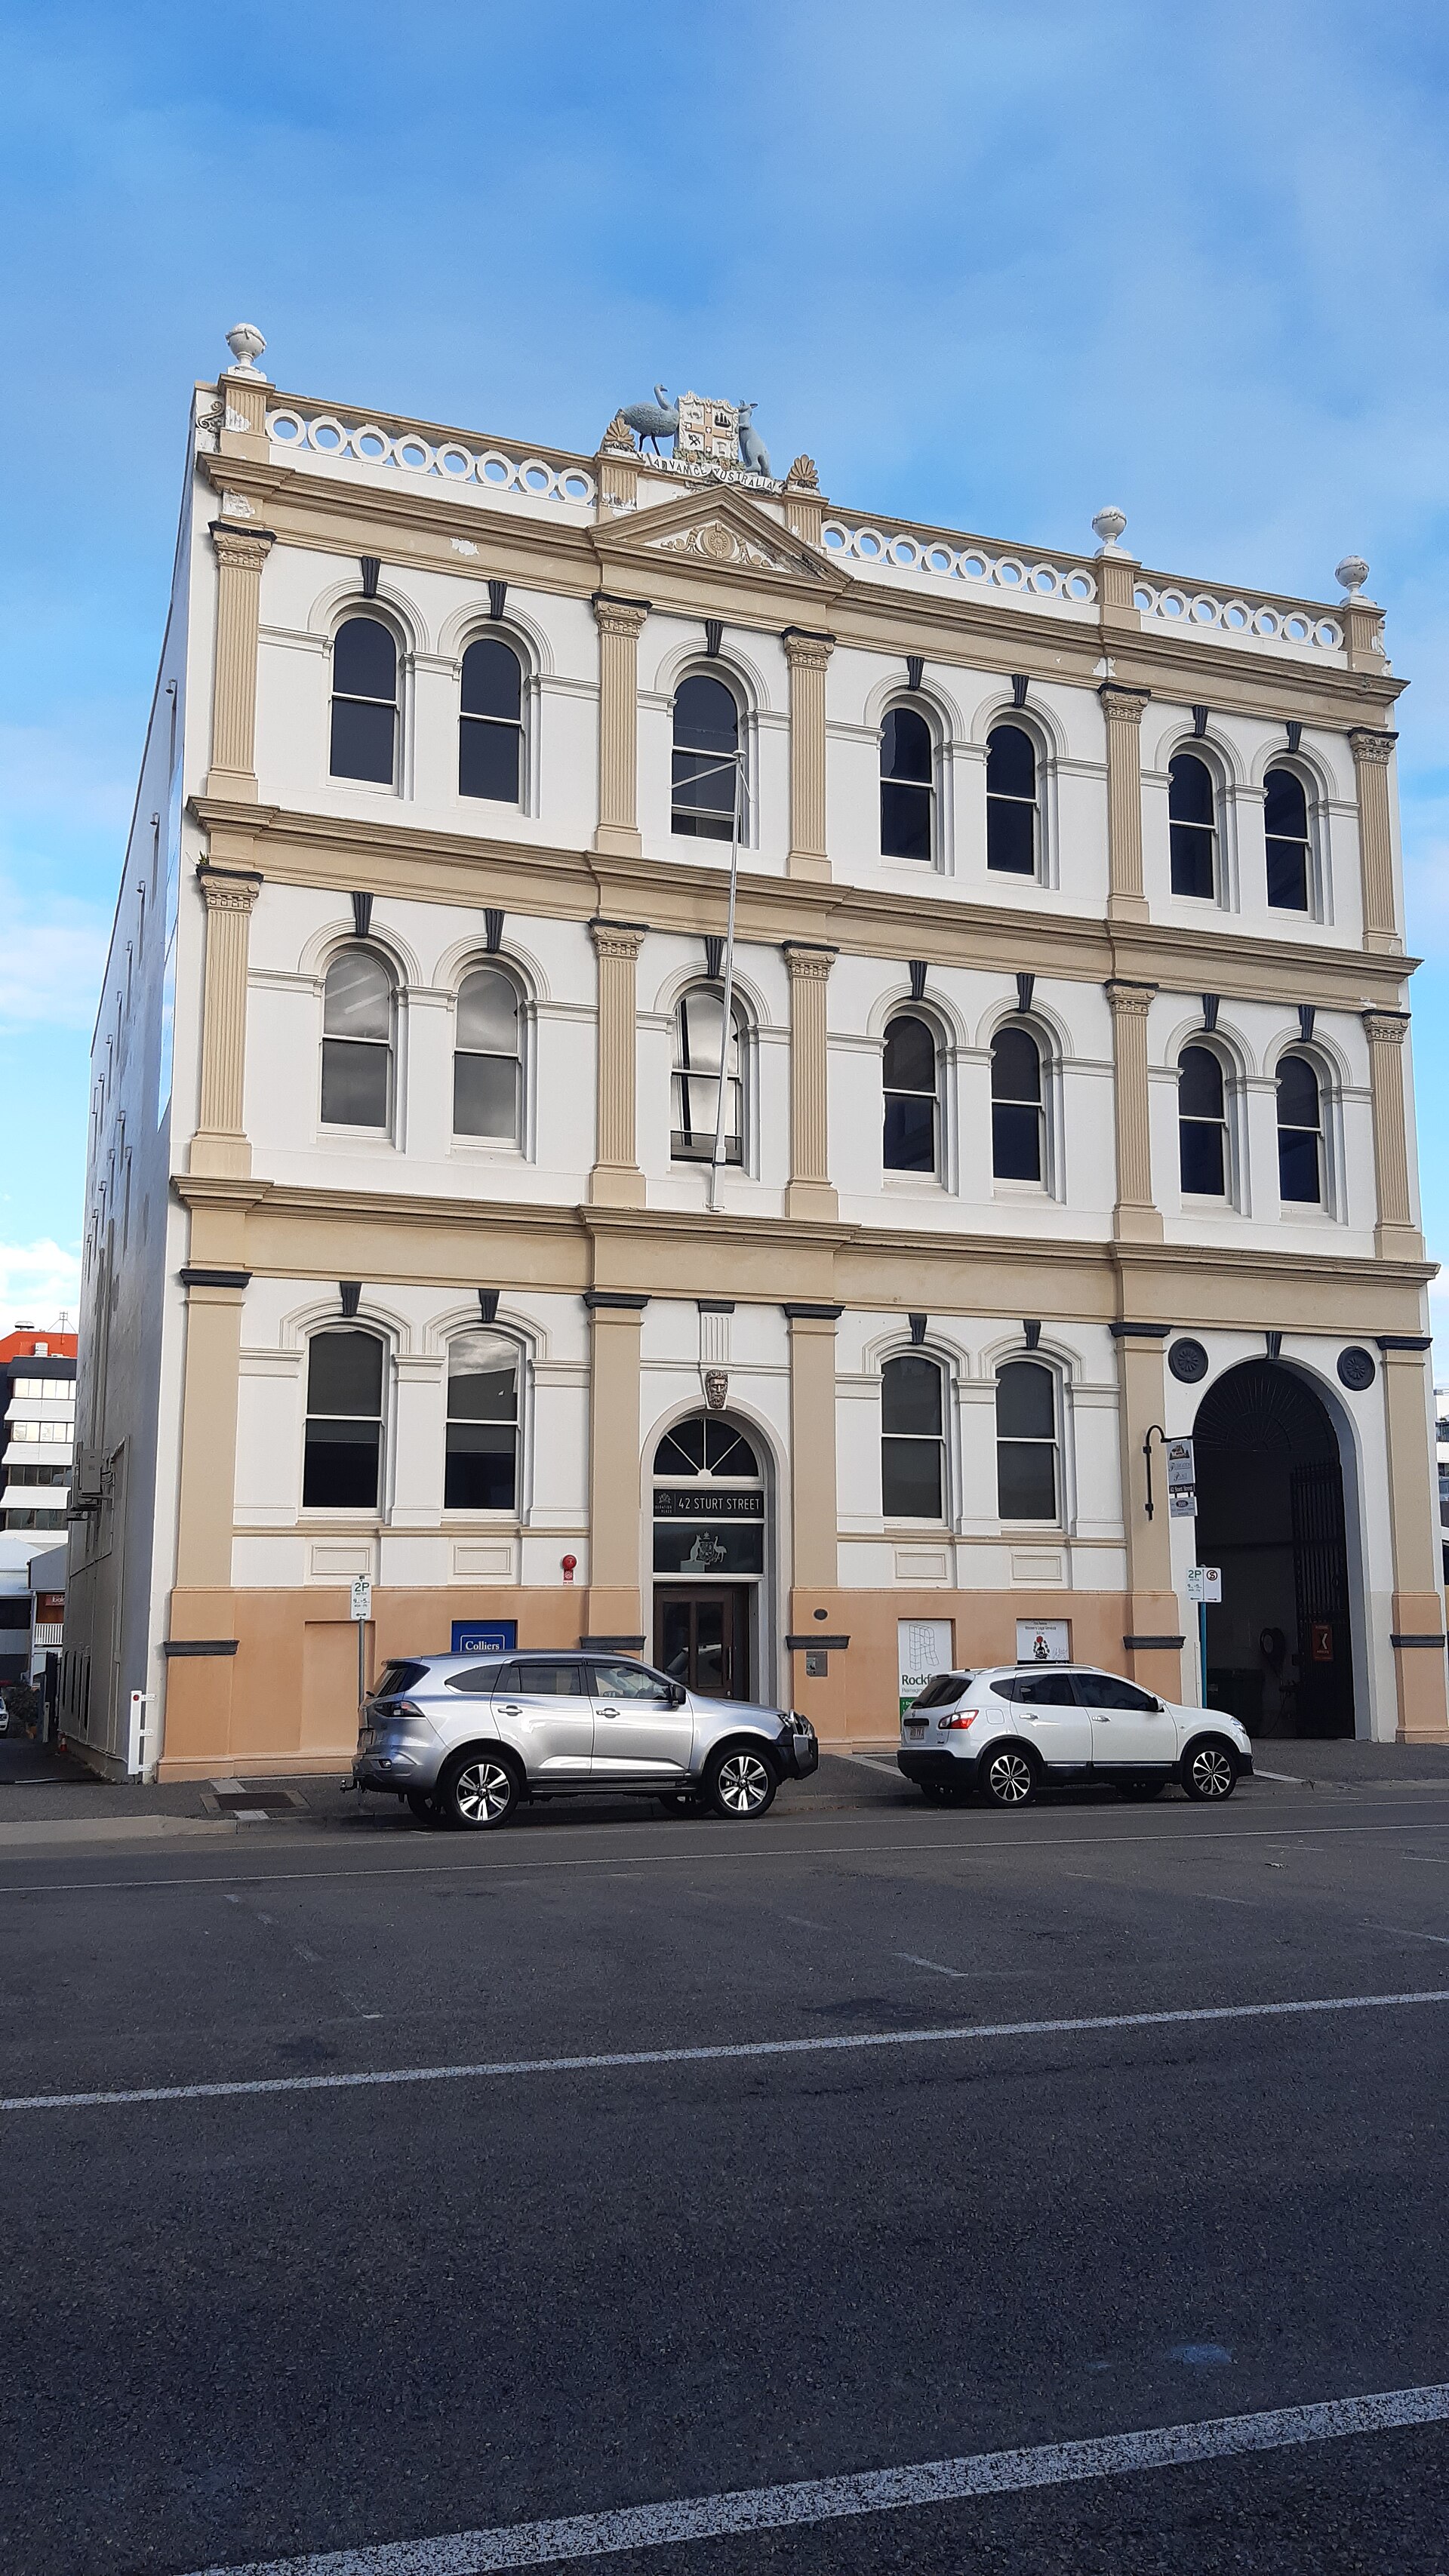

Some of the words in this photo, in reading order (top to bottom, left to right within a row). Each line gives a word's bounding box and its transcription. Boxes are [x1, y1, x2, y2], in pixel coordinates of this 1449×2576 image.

[654, 458, 707, 475] ADVANCE
[713, 468, 773, 491] AUSTRALIA
[678, 1497, 691, 1509] 42
[694, 1497, 724, 1510] STURT
[726, 1498, 759, 1510] STREET
[1188, 1569, 1201, 1578] 2P
[355, 1582, 370, 1592] 2P
[465, 1640, 500, 1651] Colliers
